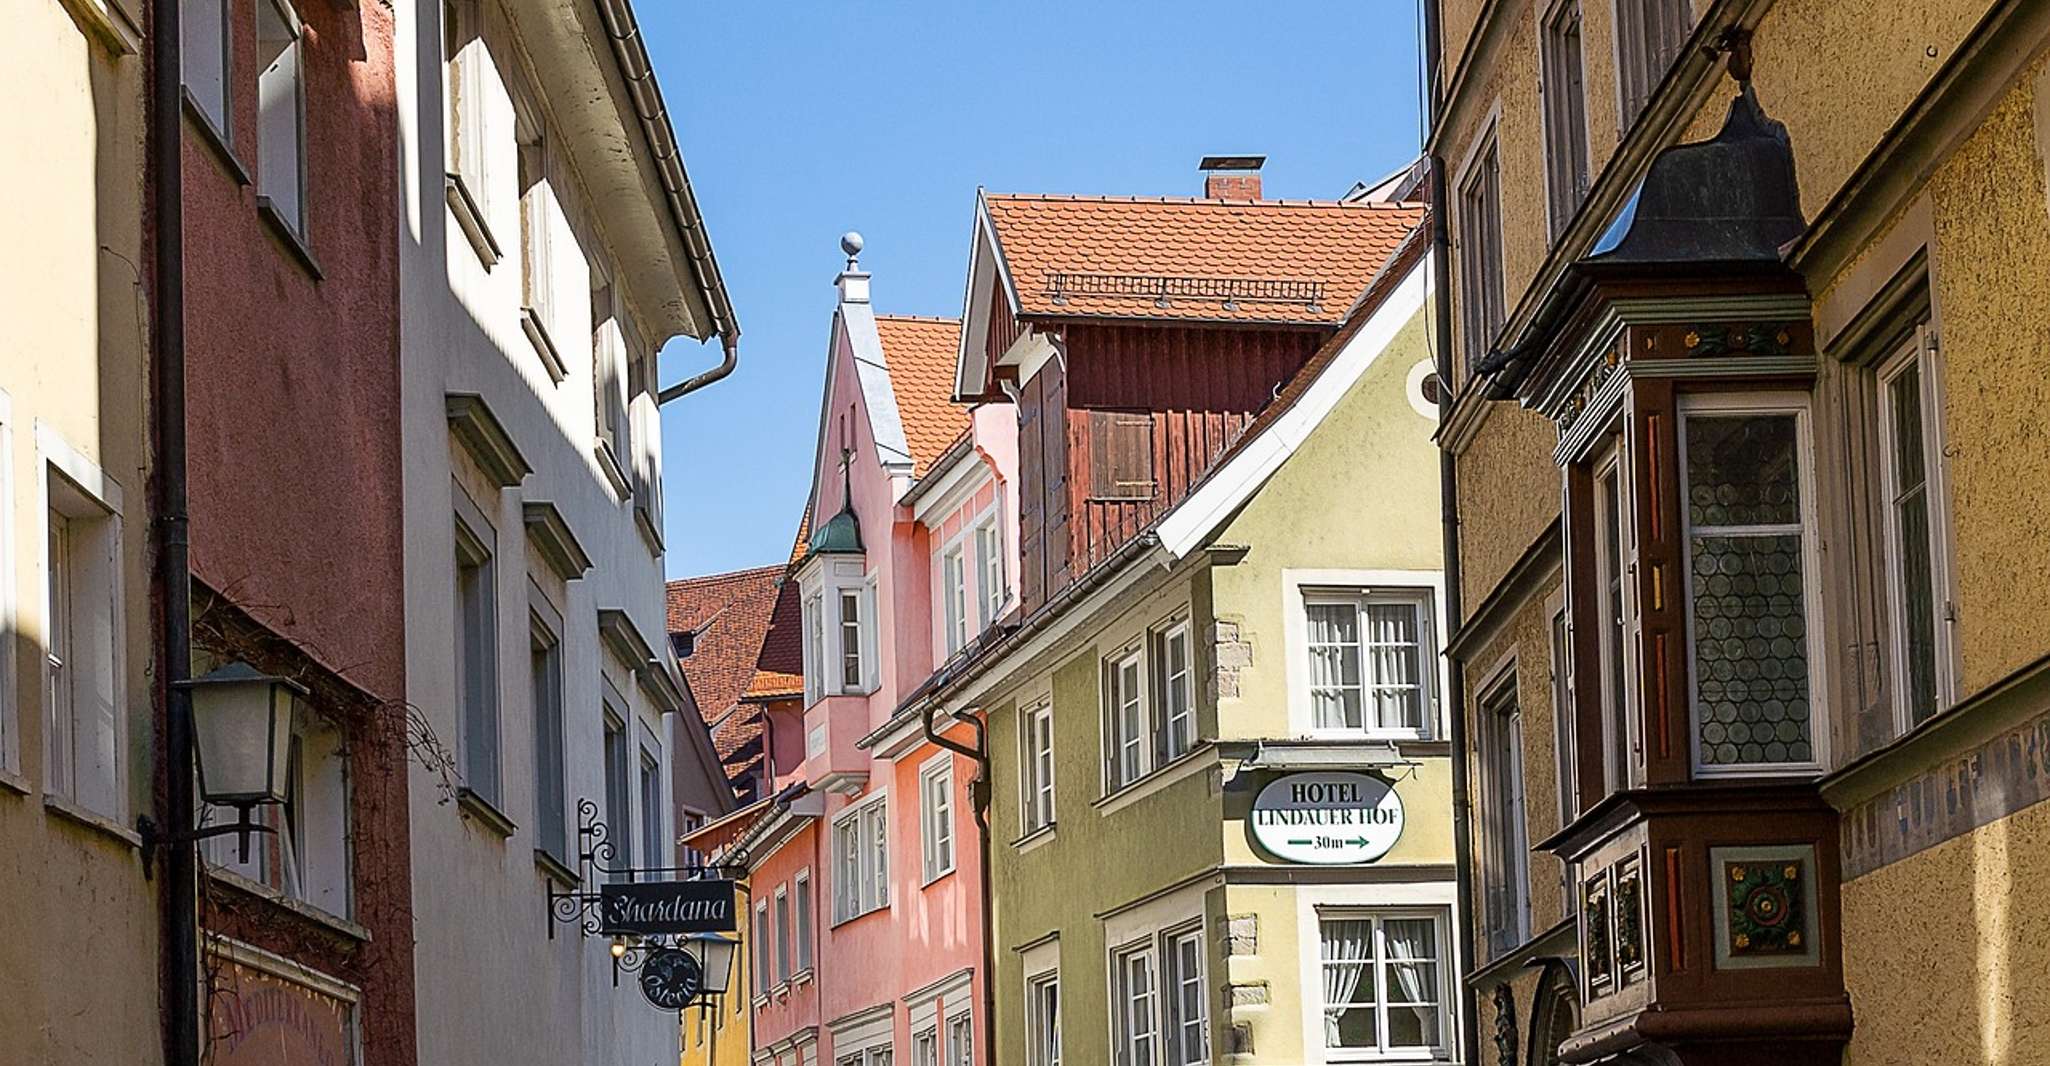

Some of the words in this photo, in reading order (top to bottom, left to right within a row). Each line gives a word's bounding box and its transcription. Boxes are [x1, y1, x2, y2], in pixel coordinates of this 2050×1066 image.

[1291, 783, 1363, 803] HOTEL
[1257, 808, 1351, 826] LINDAUER
[1359, 808, 1398, 825] HOF
[1314, 836, 1344, 849] 30m
[608, 894, 727, 924] Shardana
[644, 975, 697, 1006] Osteria
